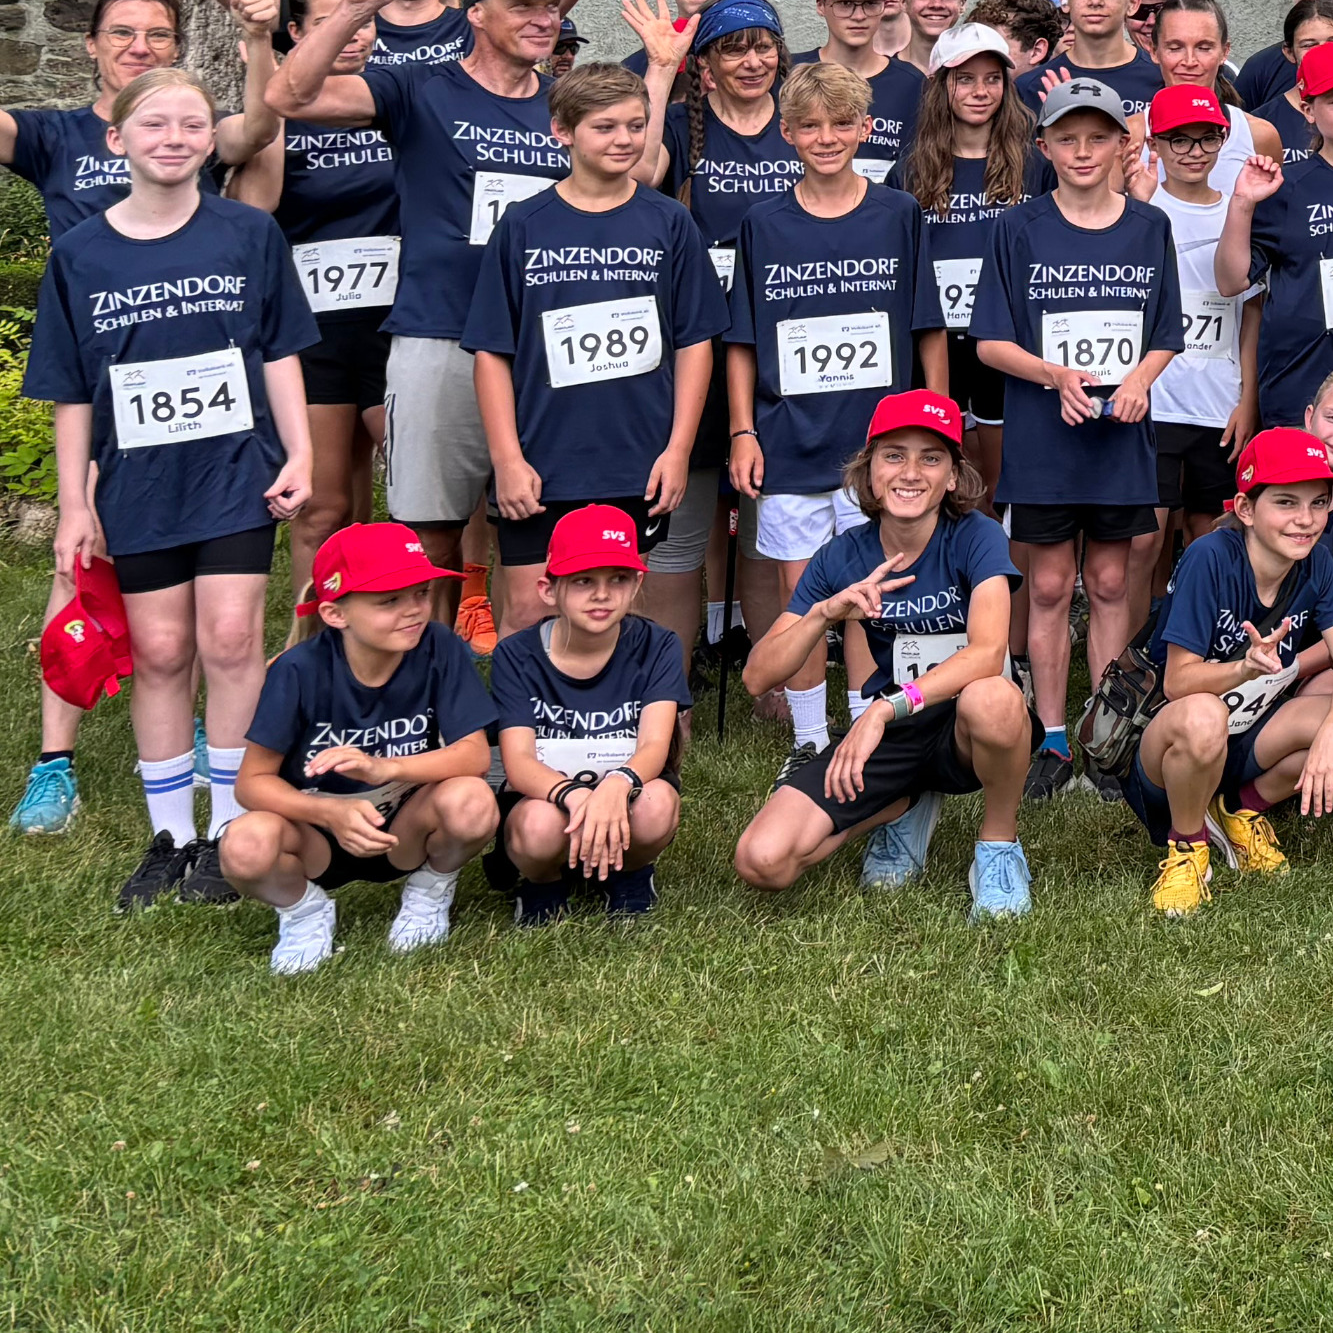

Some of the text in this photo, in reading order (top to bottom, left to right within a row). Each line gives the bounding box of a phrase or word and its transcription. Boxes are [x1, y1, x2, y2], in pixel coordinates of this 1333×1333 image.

[1192, 99, 1211, 108] SVS
[453, 121, 563, 149] ZINZENDO
[476, 143, 570, 169] SCHULEN
[708, 176, 797, 193] SCHULEN
[525, 247, 664, 270] ZINZENDORF
[306, 261, 390, 295] 1977
[525, 268, 659, 286] SCHULEN & INTERNAT
[764, 258, 899, 285] ZINZENDORF
[1029, 263, 1155, 284] ZINZENDORF
[89, 274, 246, 316] ZINZENDORF
[335, 290, 362, 302] Julia
[765, 279, 897, 302] SCHULEN & INTERNAT
[1028, 284, 1152, 300] SCHULEN & INTERNAT
[93, 299, 246, 334] SCHULEN & INTERNAT
[1182, 314, 1223, 342] 971
[560, 326, 649, 365] 1989
[794, 340, 878, 374] 1992
[1057, 337, 1133, 368] 1870
[590, 360, 629, 373] Joshua
[129, 380, 237, 426] 1854
[923, 404, 946, 417] SVS
[167, 419, 202, 435] Lilith
[1306, 447, 1325, 458] SVS
[602, 530, 625, 541] SVS
